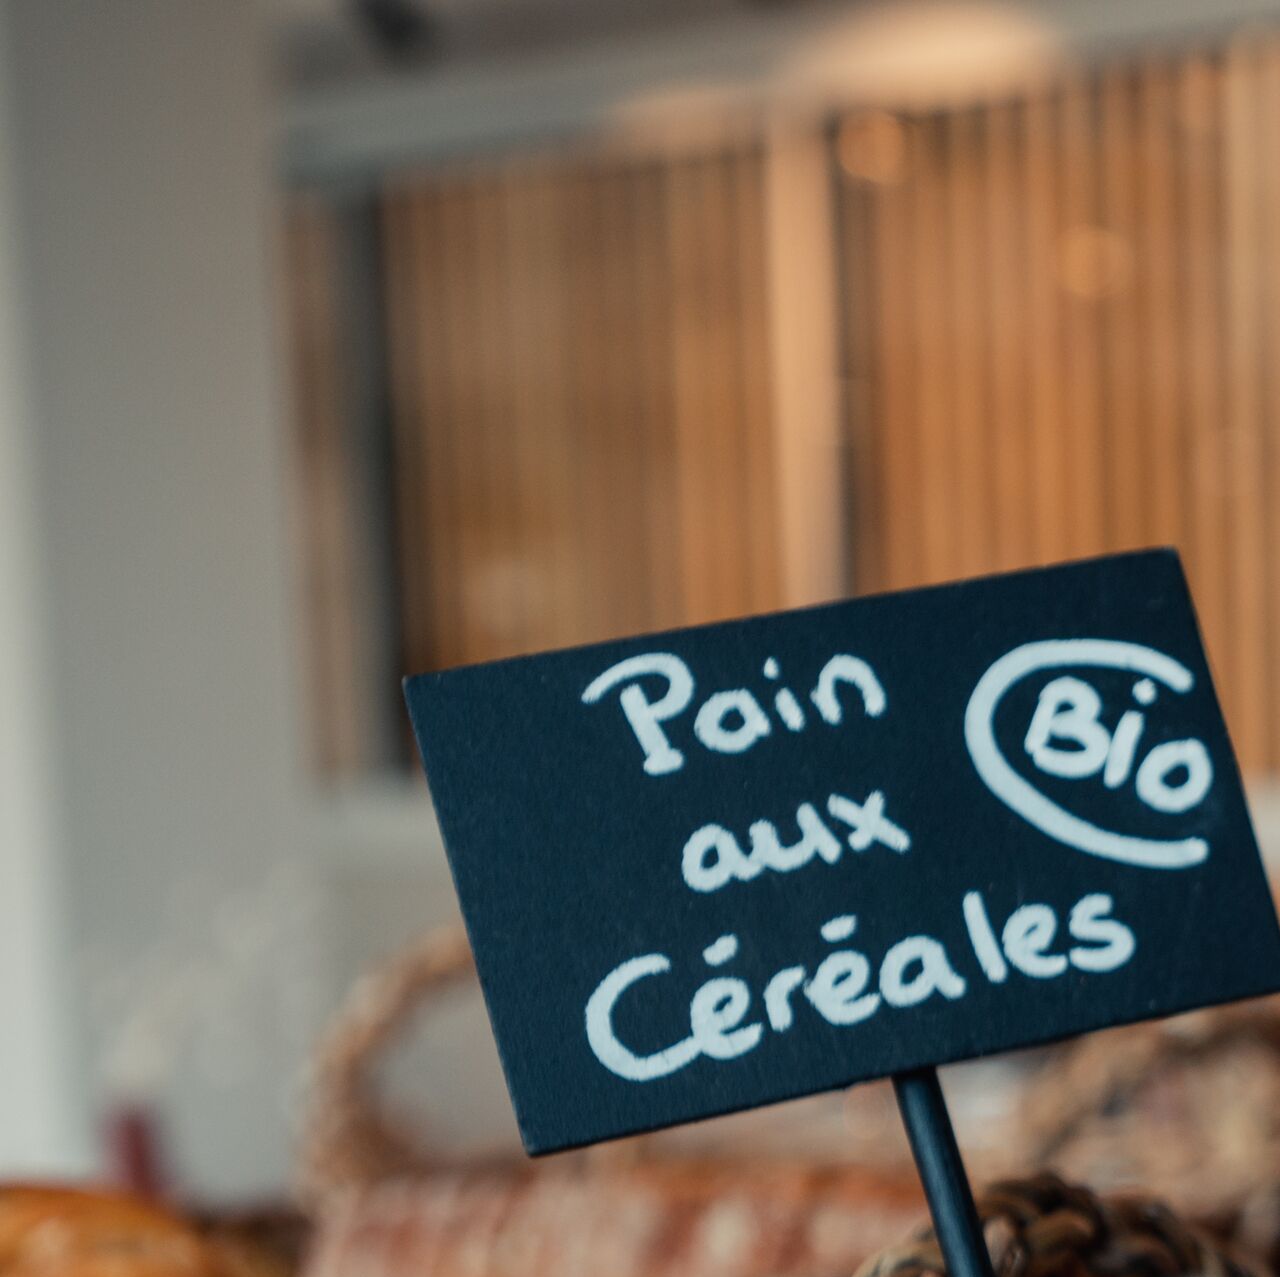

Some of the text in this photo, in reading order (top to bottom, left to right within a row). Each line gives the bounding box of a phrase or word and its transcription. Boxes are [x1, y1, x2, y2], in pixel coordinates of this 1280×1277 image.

[580, 652, 887, 776] Pain
[1024, 676, 1213, 814] Bio
[681, 790, 911, 893] aux
[584, 891, 1136, 1082] Céréales
